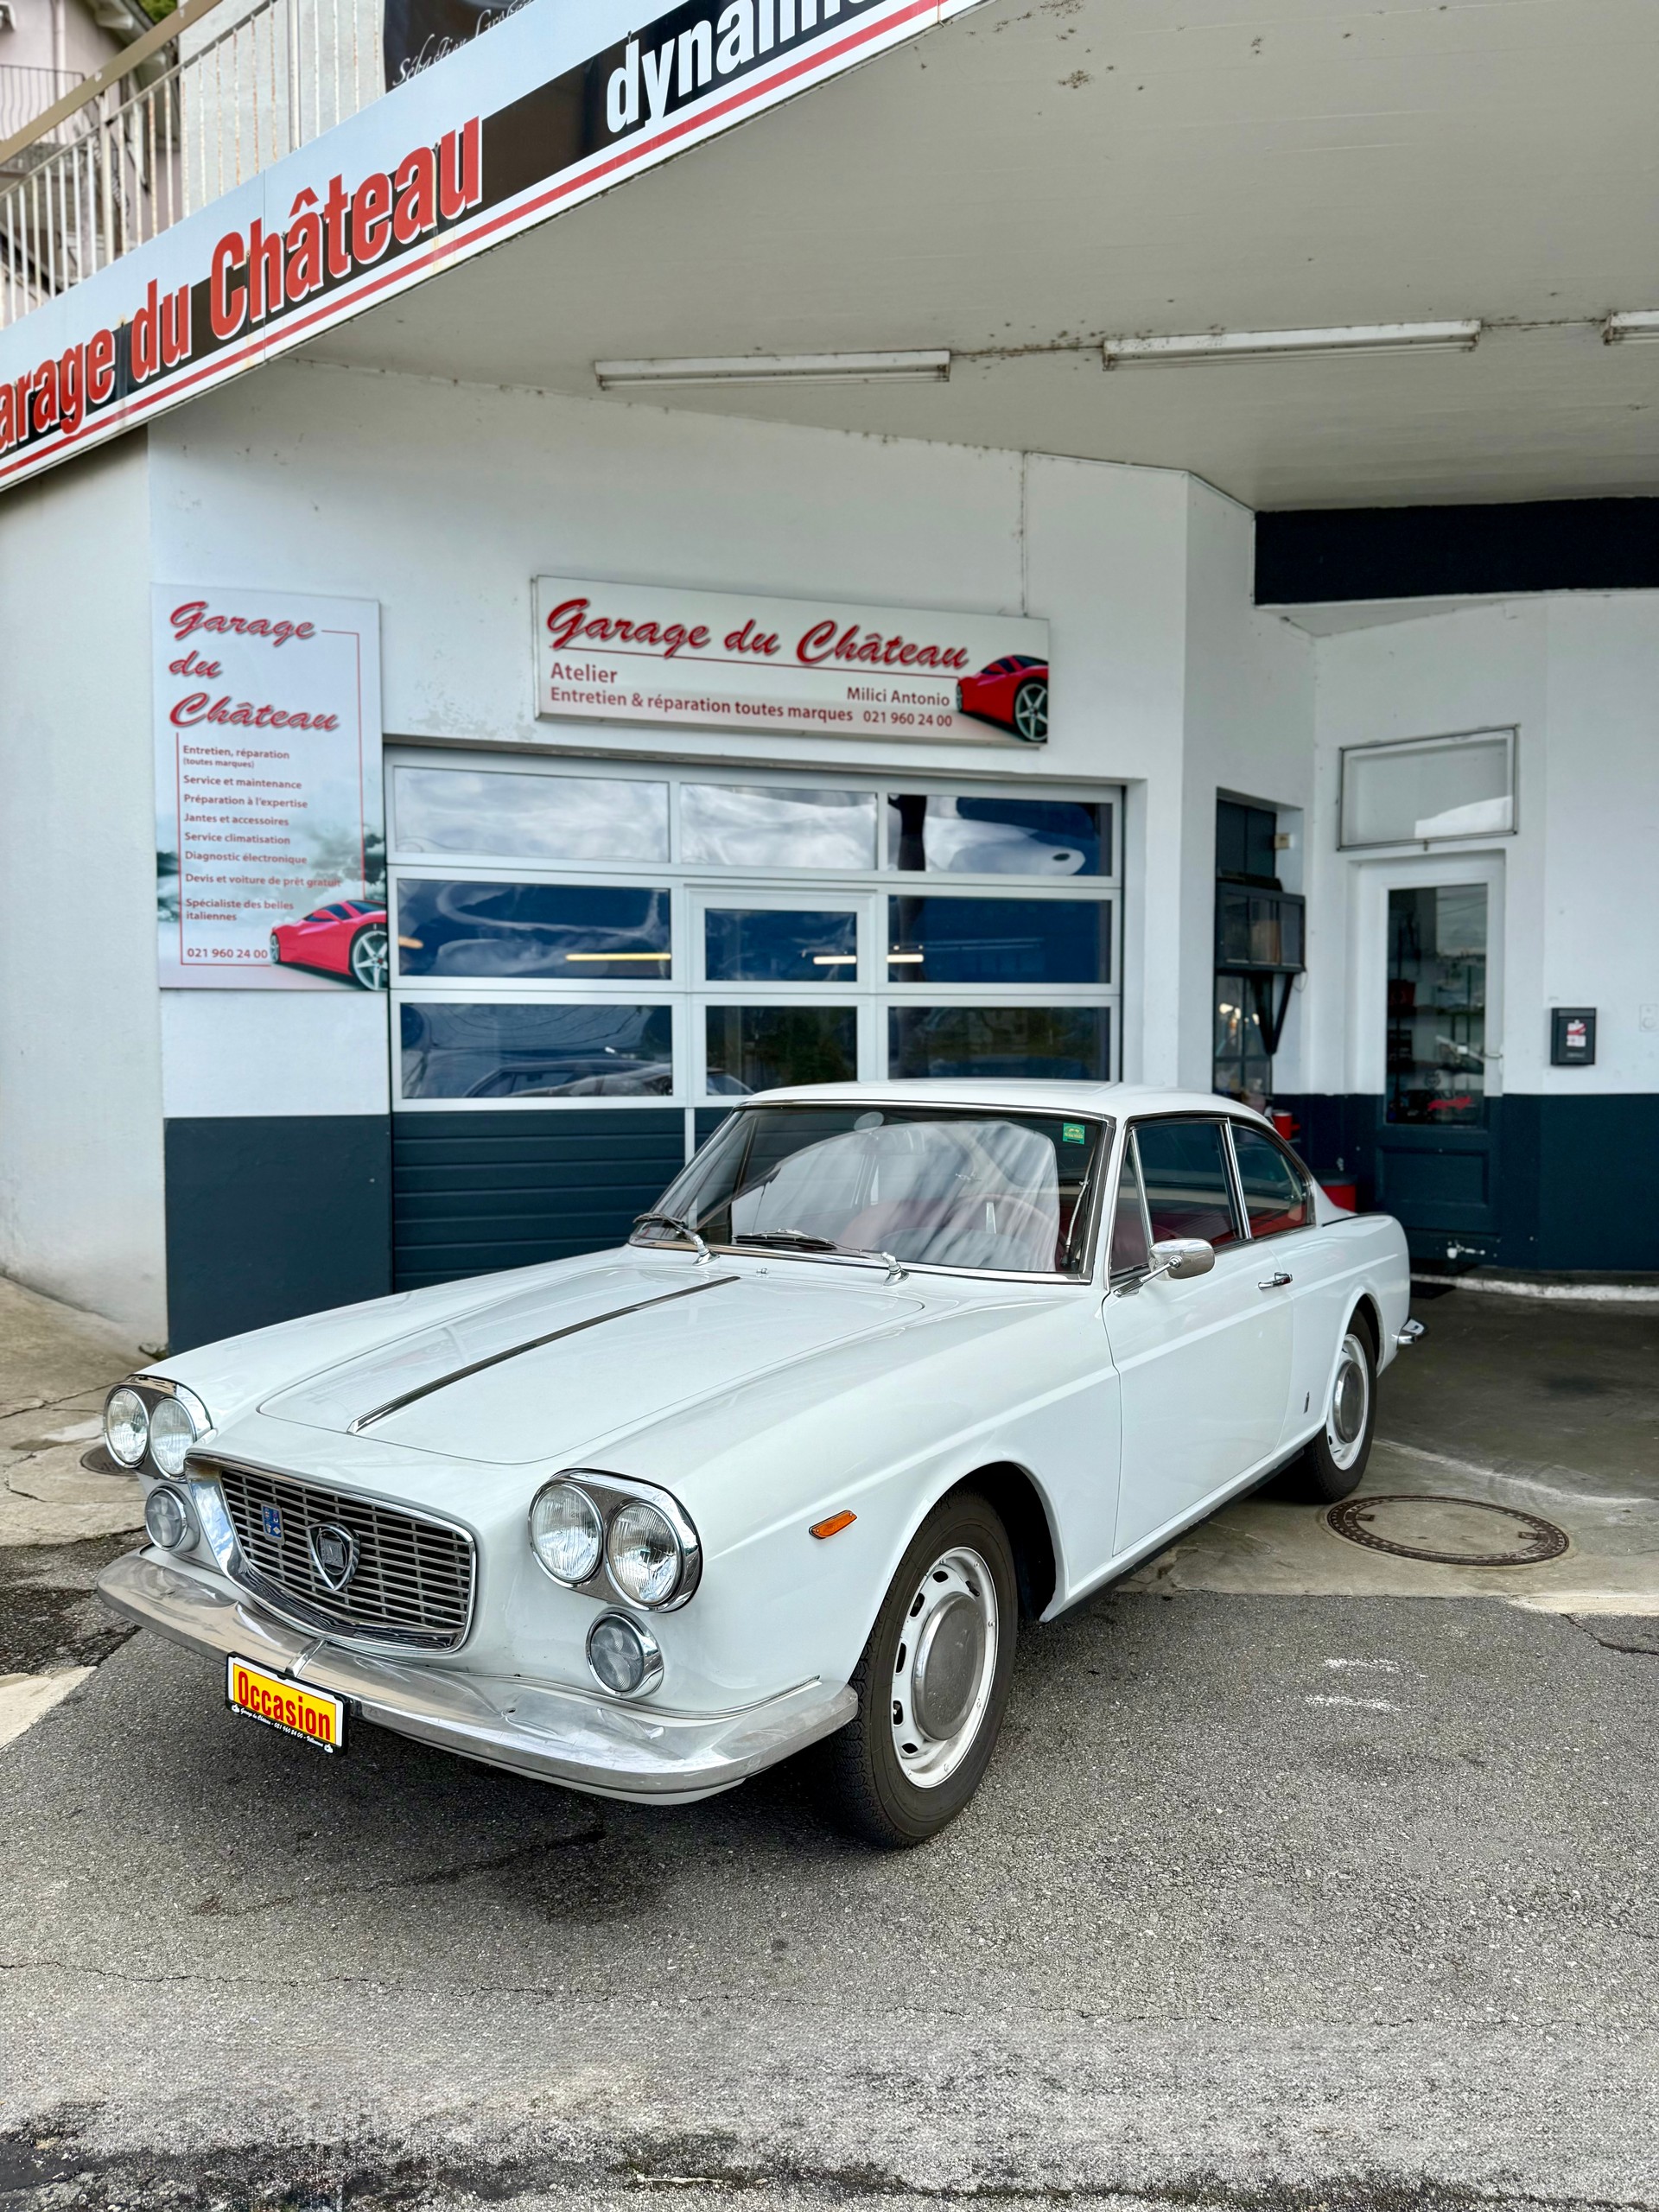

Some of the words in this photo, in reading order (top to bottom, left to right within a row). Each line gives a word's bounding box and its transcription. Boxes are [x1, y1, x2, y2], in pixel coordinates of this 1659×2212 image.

[131, 278, 192, 383] du
[211, 116, 482, 340] Château
[169, 601, 315, 647] Garage
[546, 597, 710, 659] Garage
[723, 619, 781, 656] du
[796, 620, 970, 668] Château
[168, 650, 221, 678] du
[550, 662, 617, 683] Atelier
[847, 687, 887, 702] Milici
[891, 690, 950, 707] Antonio
[169, 691, 340, 731] Château
[551, 687, 626, 706] Entretien
[631, 693, 643, 707] &
[648, 694, 731, 714] réparation
[734, 702, 783, 717] toutes
[788, 705, 853, 722] marques
[863, 710, 886, 723] 021
[891, 712, 914, 725] 960
[918, 714, 933, 726] 24
[937, 714, 952, 727] 00
[183, 745, 233, 758] Entretien,
[237, 748, 290, 760] réparation
[183, 758, 214, 767] (toutes
[216, 760, 254, 769] marques)
[183, 775, 221, 785] Service
[223, 778, 233, 786] et
[236, 779, 302, 789] maintenance
[184, 794, 245, 807] Préparation
[247, 796, 253, 805] à
[184, 813, 217, 823] Jantes
[232, 816, 289, 826] accessoires
[185, 832, 222, 842] Service
[225, 833, 290, 845] climatisation
[185, 851, 240, 863] Diagnostic
[242, 852, 308, 865] électronique
[186, 874, 214, 883] Devis
[216, 875, 227, 884] et
[229, 876, 266, 885] voiture
[268, 876, 282, 886] de
[283, 876, 304, 888] prêt
[307, 878, 340, 888] gratuit
[186, 898, 242, 911] Spécialiste
[244, 899, 261, 909] des
[264, 899, 294, 910] belles
[187, 911, 237, 921] italiennes
[187, 949, 207, 958] 021
[212, 949, 233, 959] 960
[237, 949, 251, 959] 24
[253, 950, 268, 959] 00
[238, 1671, 330, 1740] Occasion
